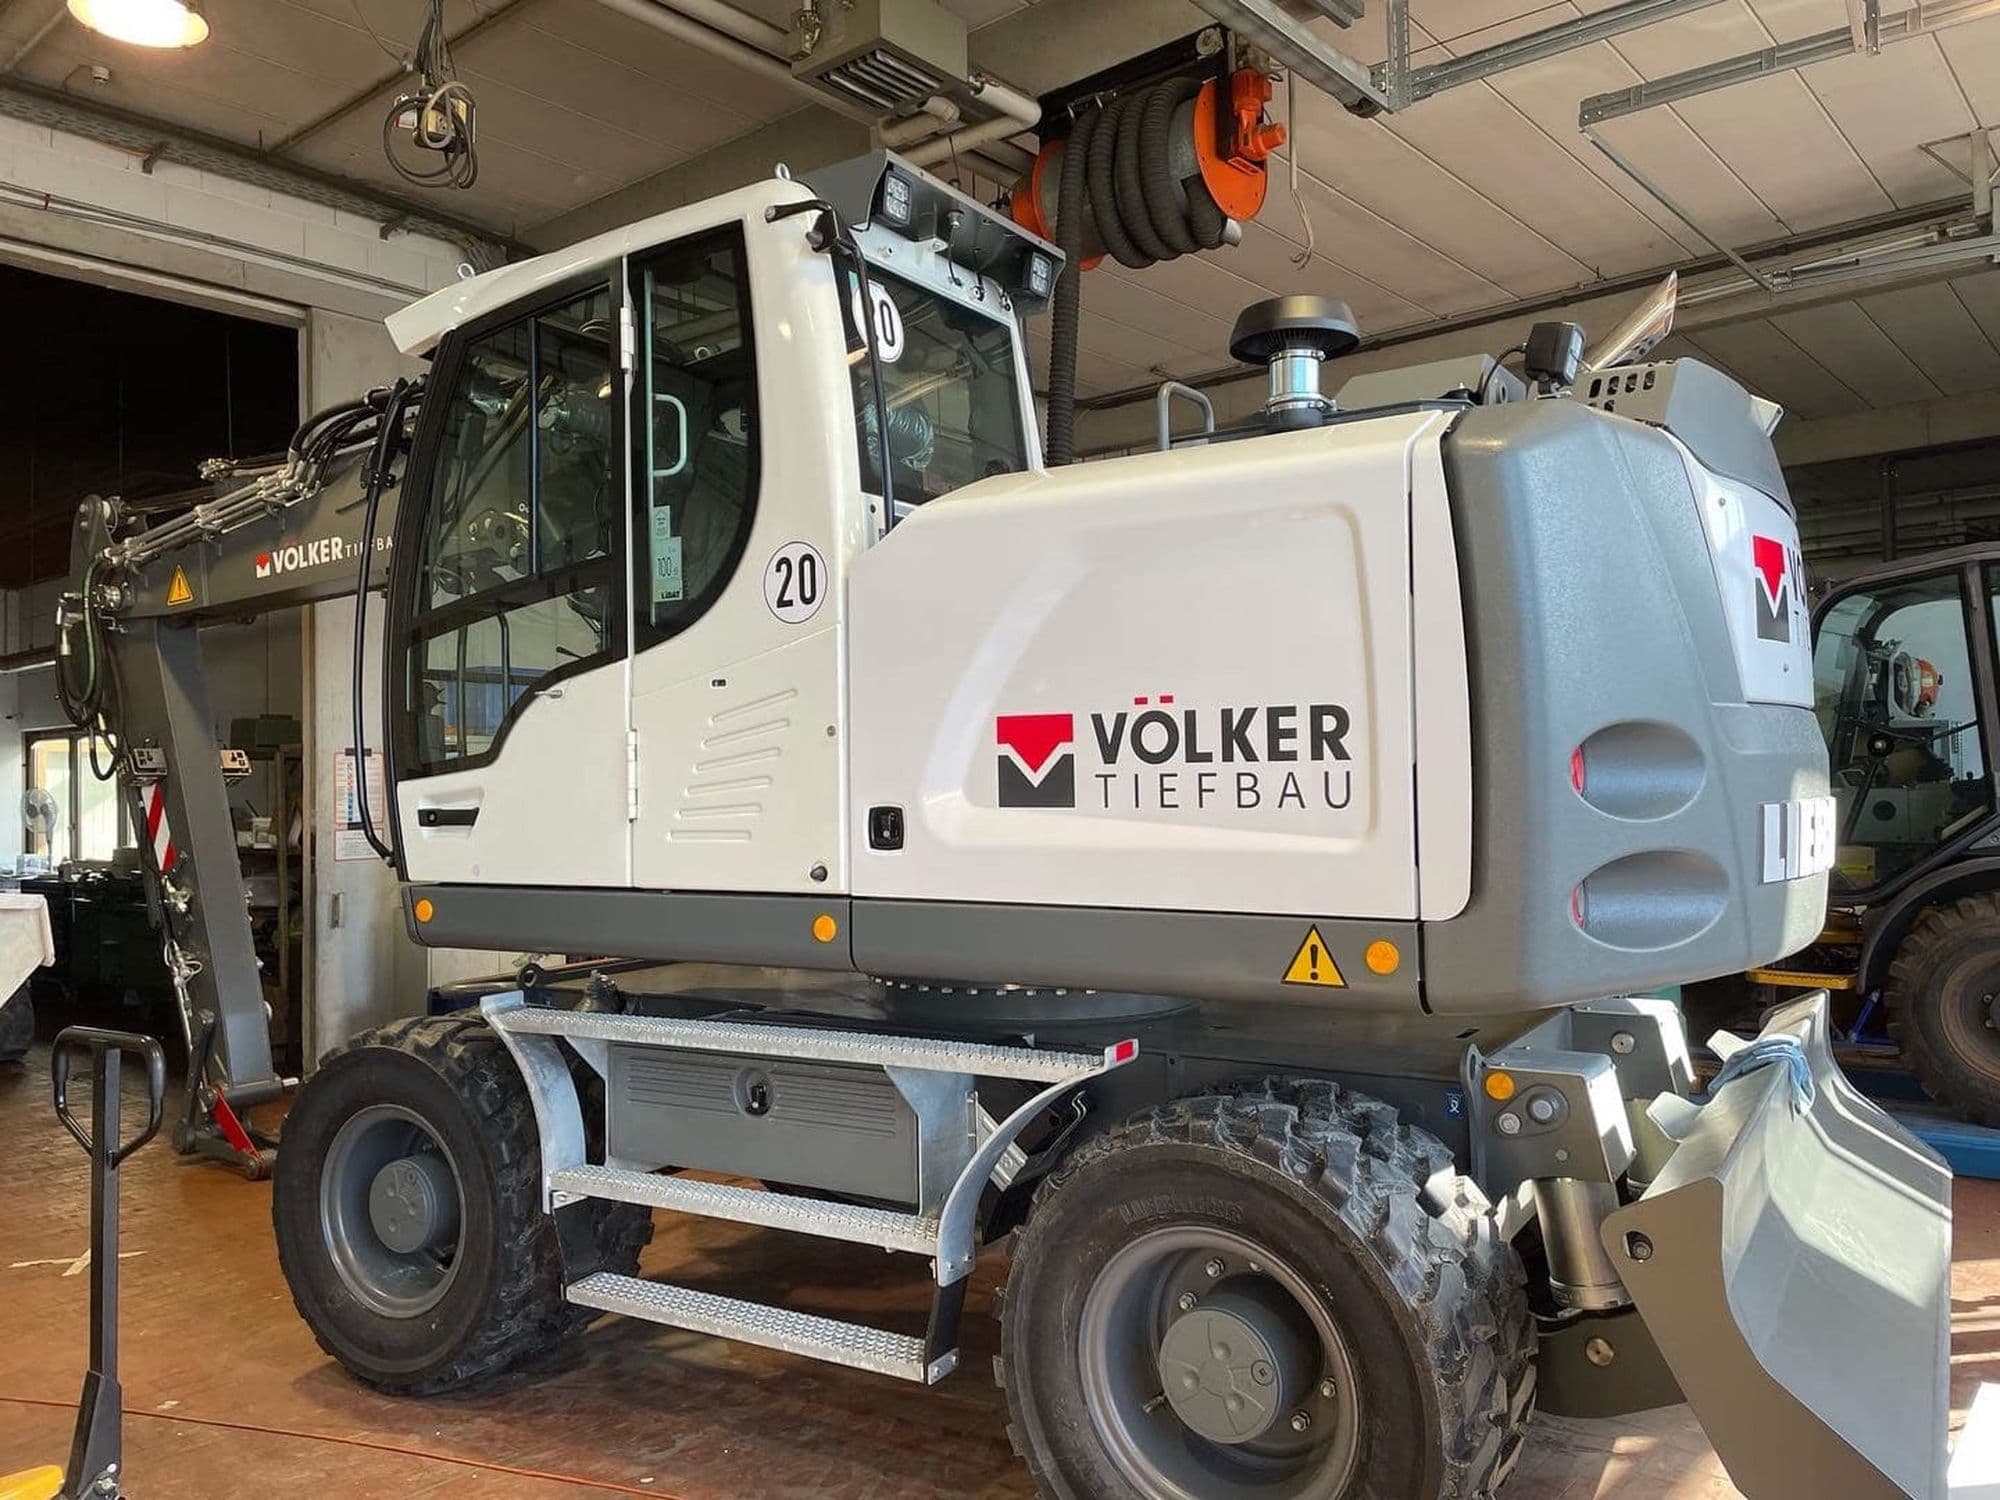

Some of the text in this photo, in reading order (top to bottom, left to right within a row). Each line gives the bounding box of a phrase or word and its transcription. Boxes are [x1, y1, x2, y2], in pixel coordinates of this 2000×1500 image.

[877, 299, 896, 347] 0
[775, 553, 817, 608] 20
[1091, 695, 1352, 765] VÖLKER
[1095, 771, 1352, 809] TIEFBAU
